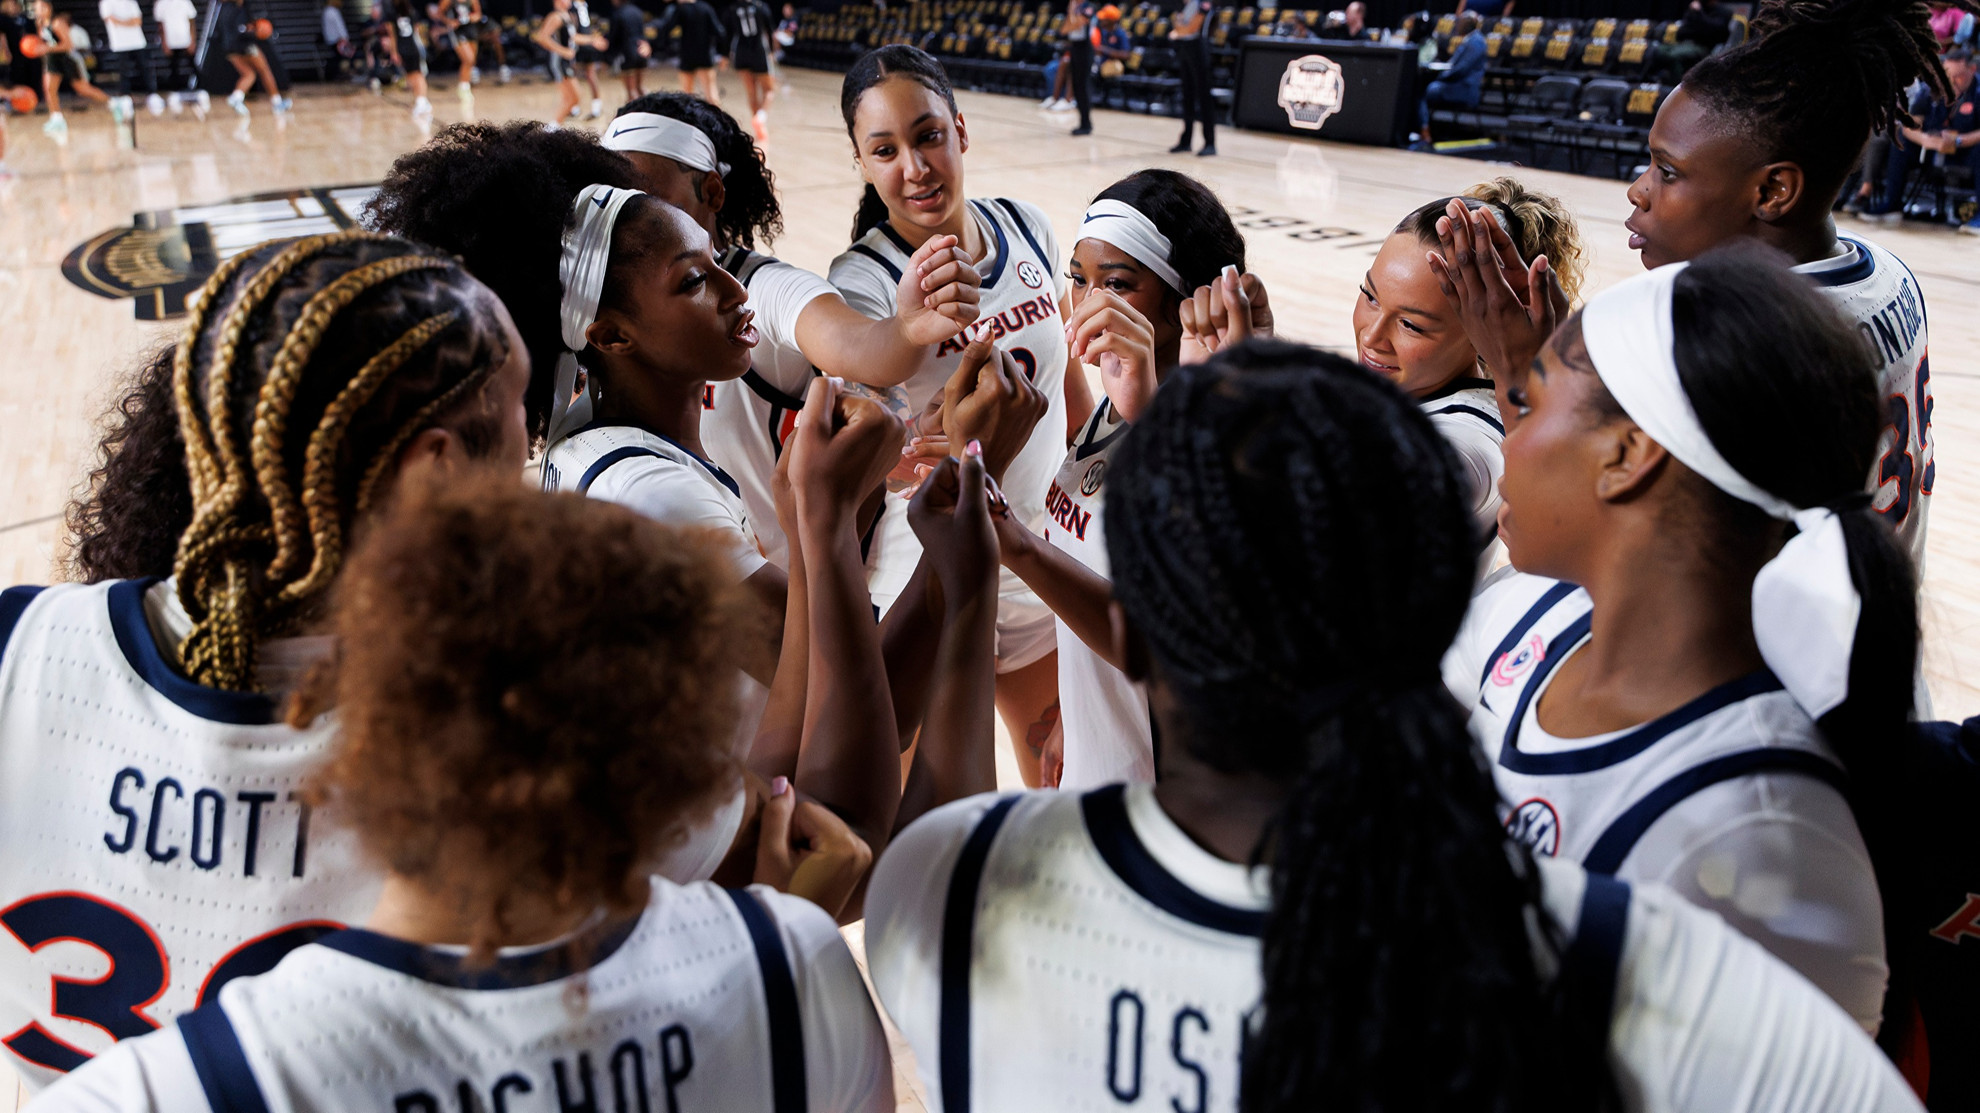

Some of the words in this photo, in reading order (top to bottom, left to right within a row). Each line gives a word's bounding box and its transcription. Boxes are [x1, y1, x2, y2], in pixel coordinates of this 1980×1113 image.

[1018, 261, 1042, 289] SEC
[936, 292, 1056, 358] AUBURN
[104, 767, 311, 878] SCOTT
[1106, 988, 1265, 1113] OS
